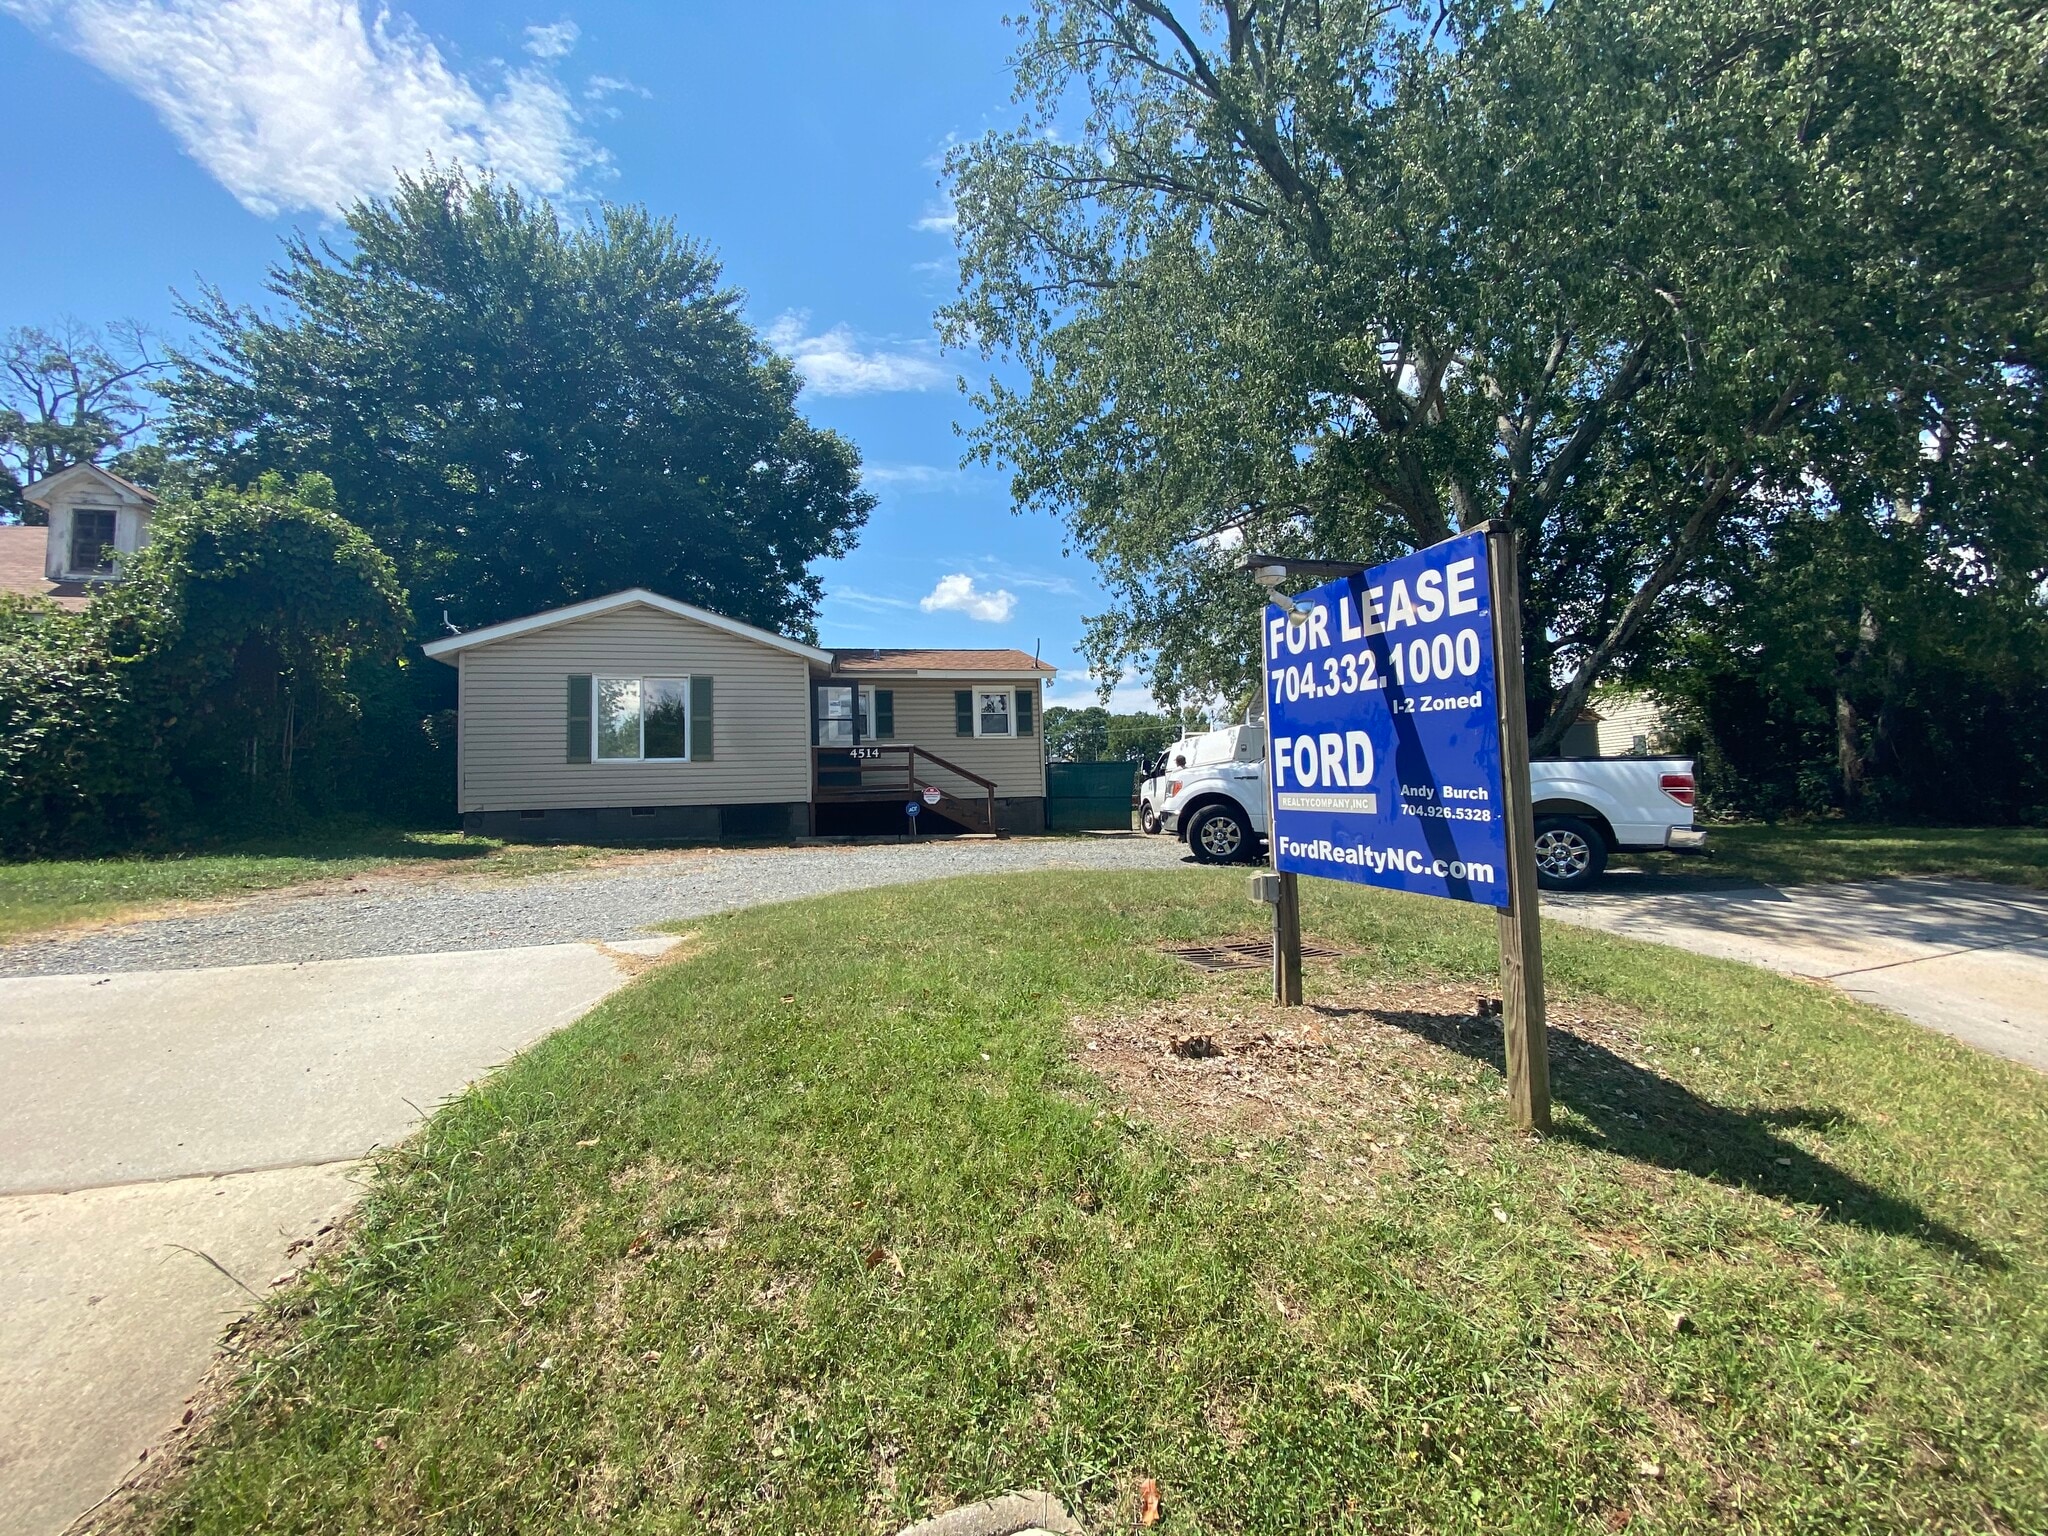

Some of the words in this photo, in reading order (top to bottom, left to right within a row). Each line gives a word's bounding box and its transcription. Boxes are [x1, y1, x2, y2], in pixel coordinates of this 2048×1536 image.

[1270, 604, 1331, 660] FOR
[1339, 557, 1478, 643] LEASE
[1271, 628, 1480, 704] 704.332.1000
[1393, 697, 1415, 714] I-2
[1420, 691, 1482, 712] Zoned
[850, 749, 879, 758] 4514
[1274, 730, 1374, 787] FORD
[1401, 784, 1434, 800] Andy
[1443, 786, 1489, 800] Burch
[1401, 804, 1491, 822] 704.926.5328
[1279, 836, 1495, 883] FordRealtyNC.com
